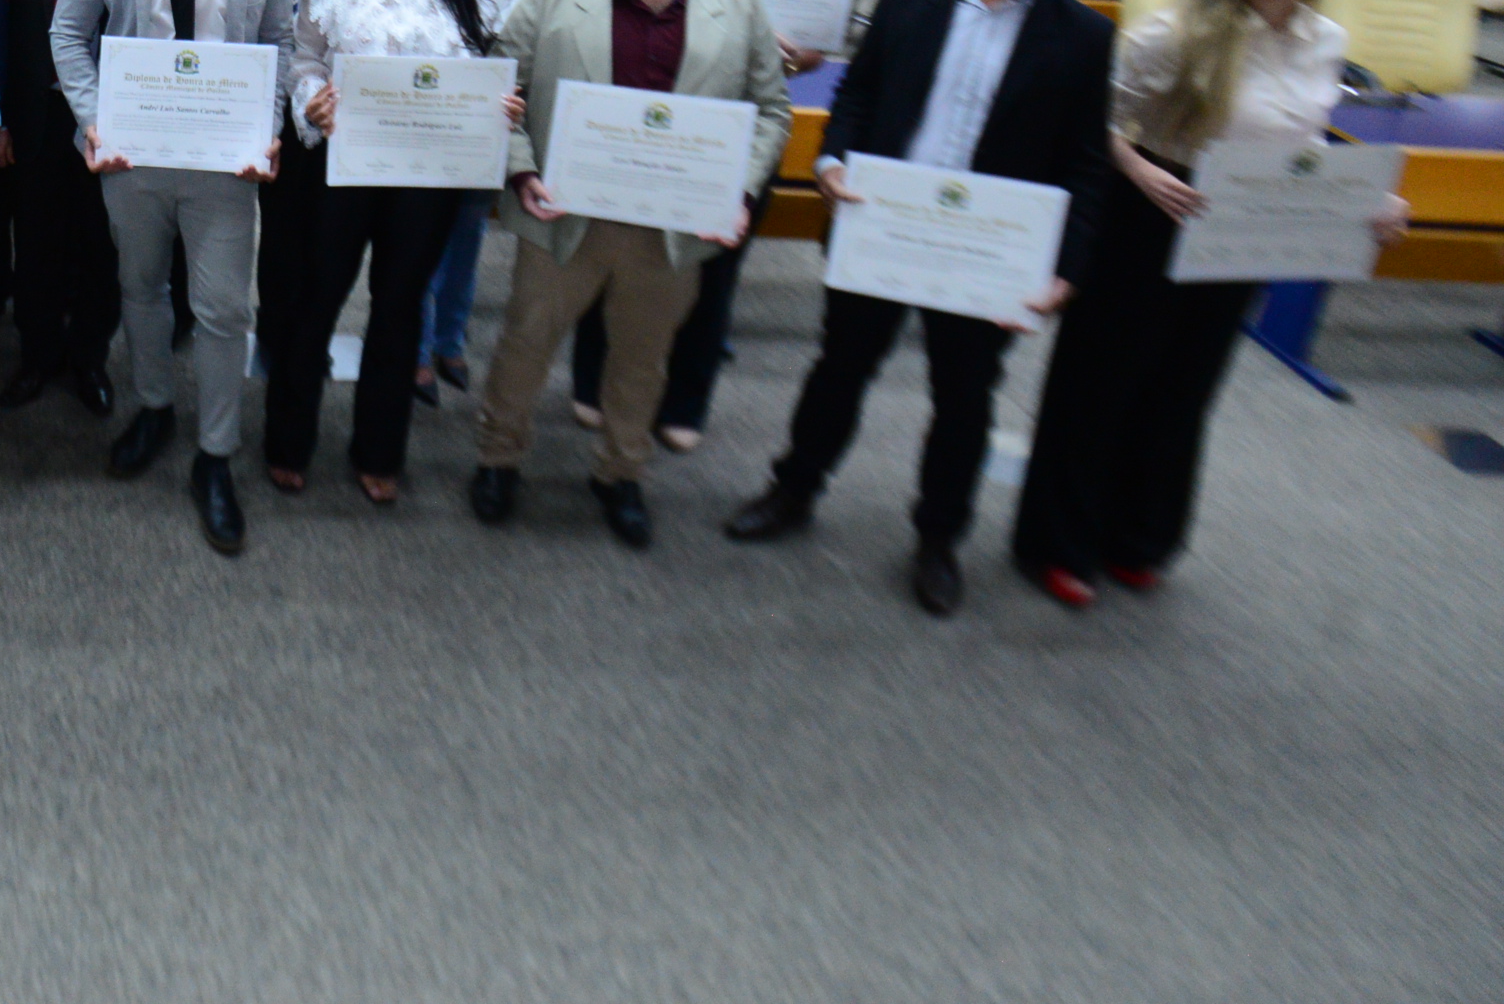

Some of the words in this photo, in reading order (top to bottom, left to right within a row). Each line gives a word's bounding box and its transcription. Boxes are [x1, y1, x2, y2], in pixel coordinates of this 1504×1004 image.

[124, 72, 161, 84] Diploma
[163, 75, 172, 84] de
[205, 78, 216, 87] ao
[200, 107, 231, 116] Carvalho
